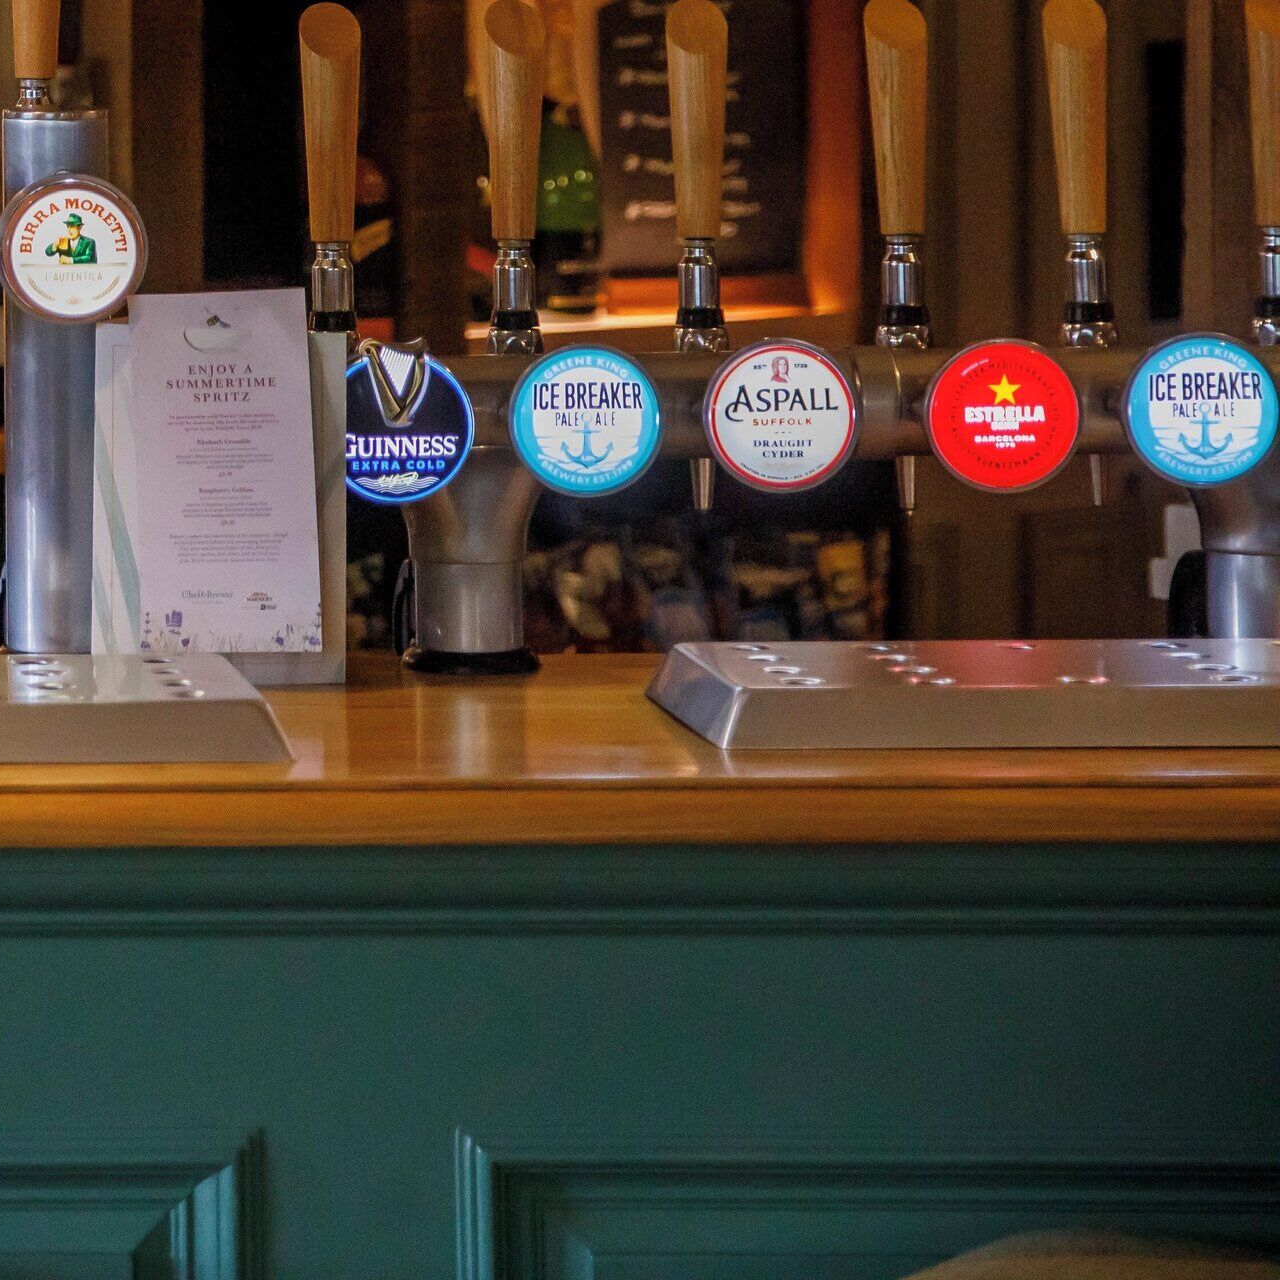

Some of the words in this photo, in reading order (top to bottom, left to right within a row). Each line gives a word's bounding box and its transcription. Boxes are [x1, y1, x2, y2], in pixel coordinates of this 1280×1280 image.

[20, 202, 60, 254] BIRRA
[65, 198, 128, 252] MORETTI
[1159, 346, 1209, 369] GREENE
[1214, 346, 1248, 369] KING
[188, 364, 237, 377] ENJOY
[244, 364, 253, 374] A
[544, 356, 592, 379] GREENE
[597, 356, 629, 378] KING
[166, 377, 277, 389] SUMMERTIME
[1149, 373, 1177, 401] ICE
[1182, 372, 1263, 400] BREAKER
[193, 392, 251, 402] SPRITZ
[533, 383, 559, 410] ICE
[565, 382, 643, 409] BREAKER
[725, 384, 839, 422] ASPALL
[964, 405, 1046, 423] ESTRELLA
[1172, 403, 1197, 417] PALE
[1214, 402, 1235, 417] ALE
[555, 412, 578, 426] PALE
[595, 412, 616, 426] ALE
[752, 418, 812, 426] SUFFOLK
[346, 433, 457, 457] GUINNESS
[753, 439, 813, 448] DRAUGHT
[974, 435, 1036, 443] BARCELONA
[762, 450, 804, 458] CYDER
[352, 461, 400, 470] EXTRA
[406, 460, 446, 470] COLD
[541, 460, 590, 484] BREWERY
